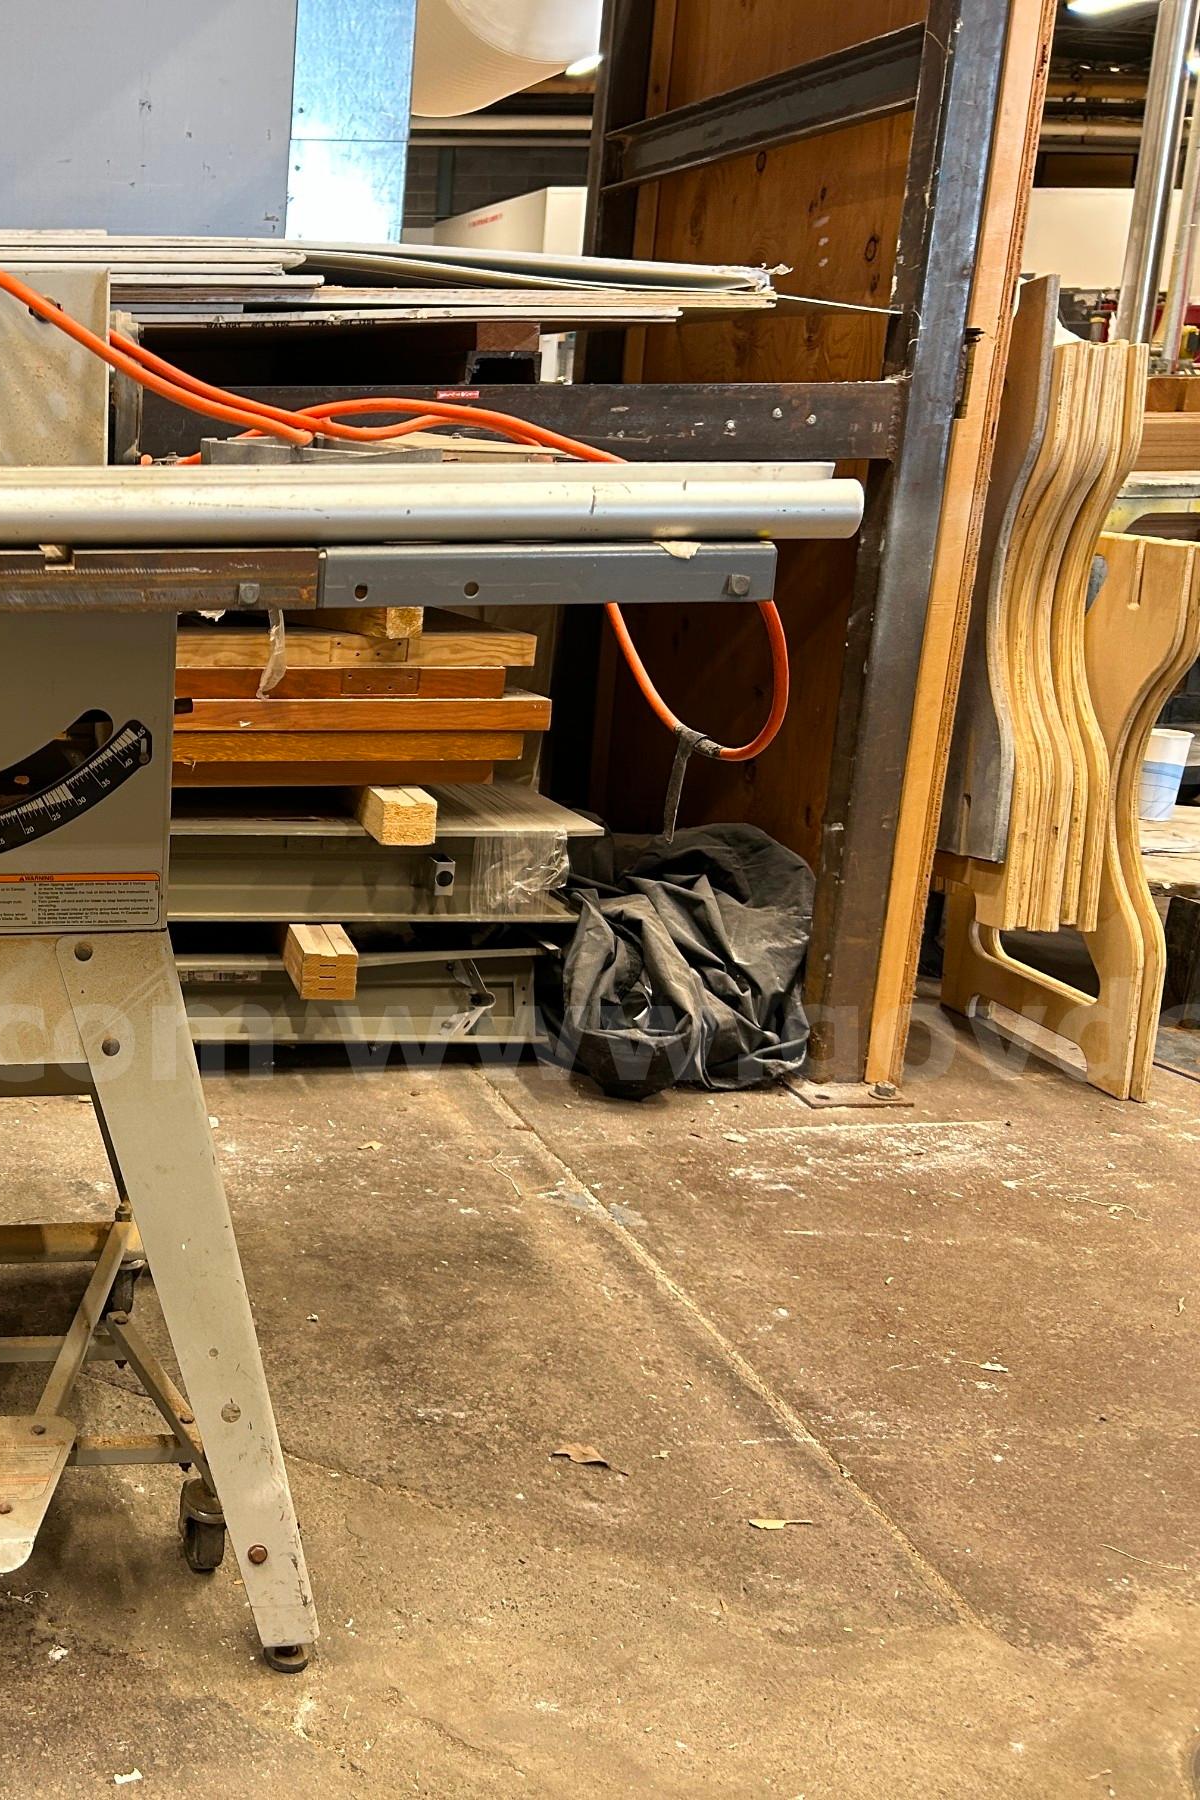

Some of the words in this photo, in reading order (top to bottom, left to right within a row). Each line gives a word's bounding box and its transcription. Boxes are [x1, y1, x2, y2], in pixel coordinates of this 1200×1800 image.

[124, 758, 133, 767] 40
[101, 779, 111, 788] 35
[77, 796, 87, 805] 30
[52, 812, 61, 821] 25
[25, 827, 35, 835] 20
